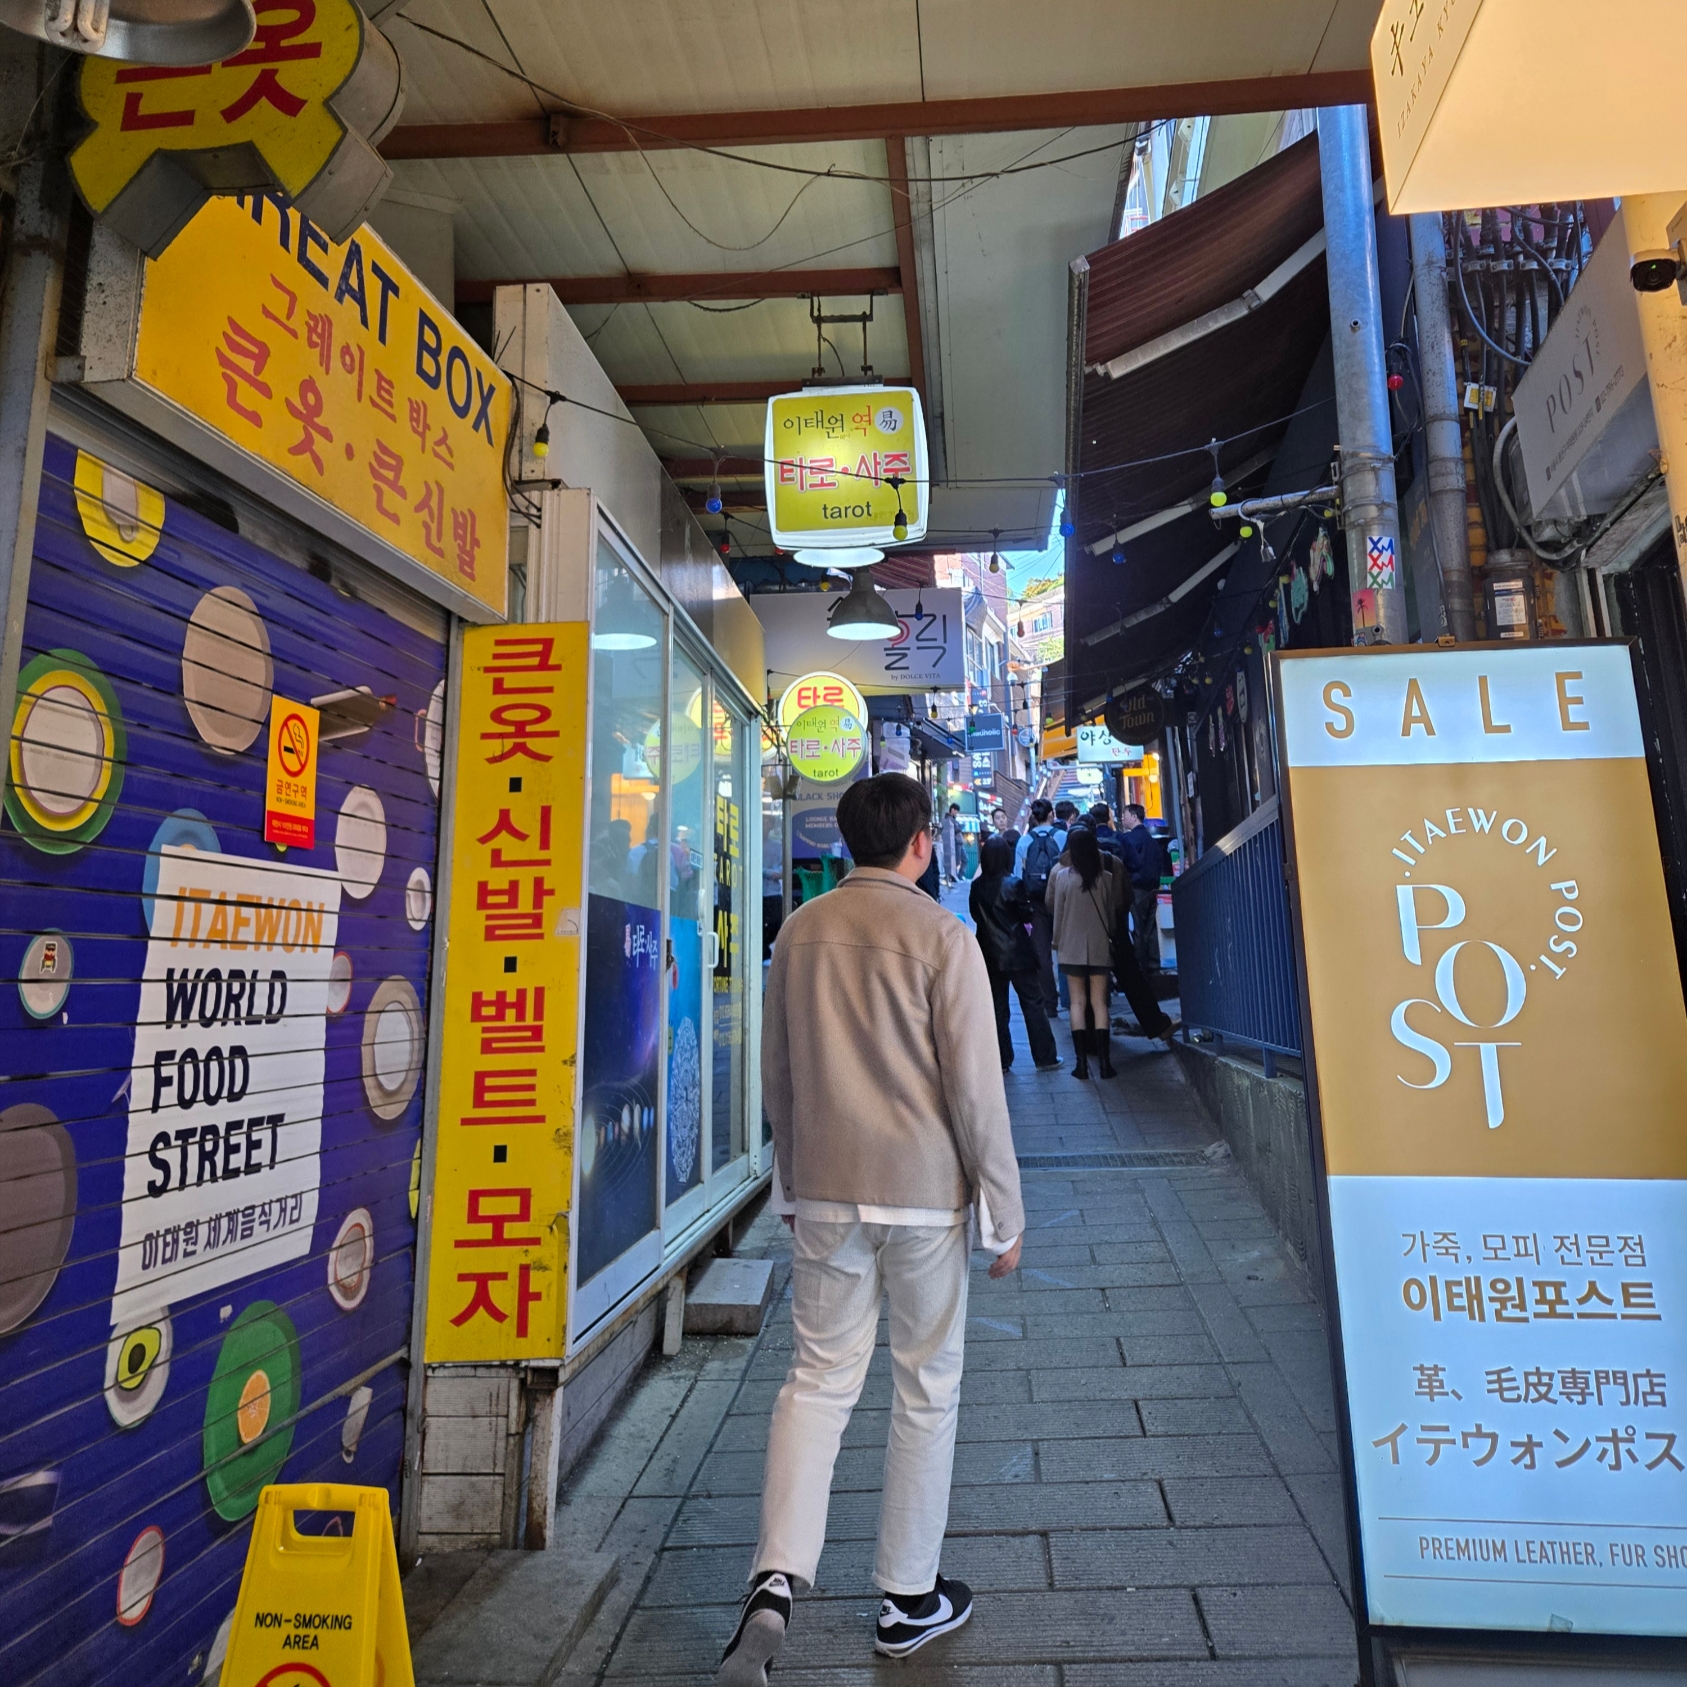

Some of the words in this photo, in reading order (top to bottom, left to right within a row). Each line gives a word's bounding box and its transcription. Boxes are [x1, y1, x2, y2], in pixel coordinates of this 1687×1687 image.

[1397, 45, 1434, 139] IZAKAYA
[236, 193, 400, 347] REAT
[415, 307, 496, 449] BOX
[1546, 331, 1594, 434] POST
[783, 409, 844, 439] 이태원
[852, 405, 872, 437] 역
[778, 451, 911, 492] 타로·사주
[822, 501, 872, 519] tarot
[797, 686, 845, 709] 타로
[1322, 671, 1590, 739] SALE
[796, 717, 827, 733] 이태원
[829, 716, 840, 732] 역
[1119, 711, 1155, 730] Town
[789, 737, 862, 760] 타로·사주
[276, 778, 307, 801] 금연구역
[813, 768, 839, 778] tarot
[716, 794, 739, 858] 타로
[1391, 806, 1557, 867] ITAEWON
[1539, 879, 1584, 980] POST
[170, 886, 325, 954] ITAEWON
[164, 966, 288, 1030] WORLD
[151, 1044, 250, 1114] FOOD
[146, 1113, 286, 1198] STREET
[141, 1218, 200, 1271] 이태원
[1401, 1230, 1472, 1264] 가죽,
[1482, 1233, 1543, 1266] 모피
[1552, 1234, 1648, 1268] 전문점
[1402, 1274, 1663, 1323] 이태원포스트
[1418, 1536, 1507, 1563] PREMIUM
[1514, 1538, 1603, 1568] LEATHER,
[1610, 1542, 1648, 1568] FUR
[282, 1634, 320, 1651] AREA
